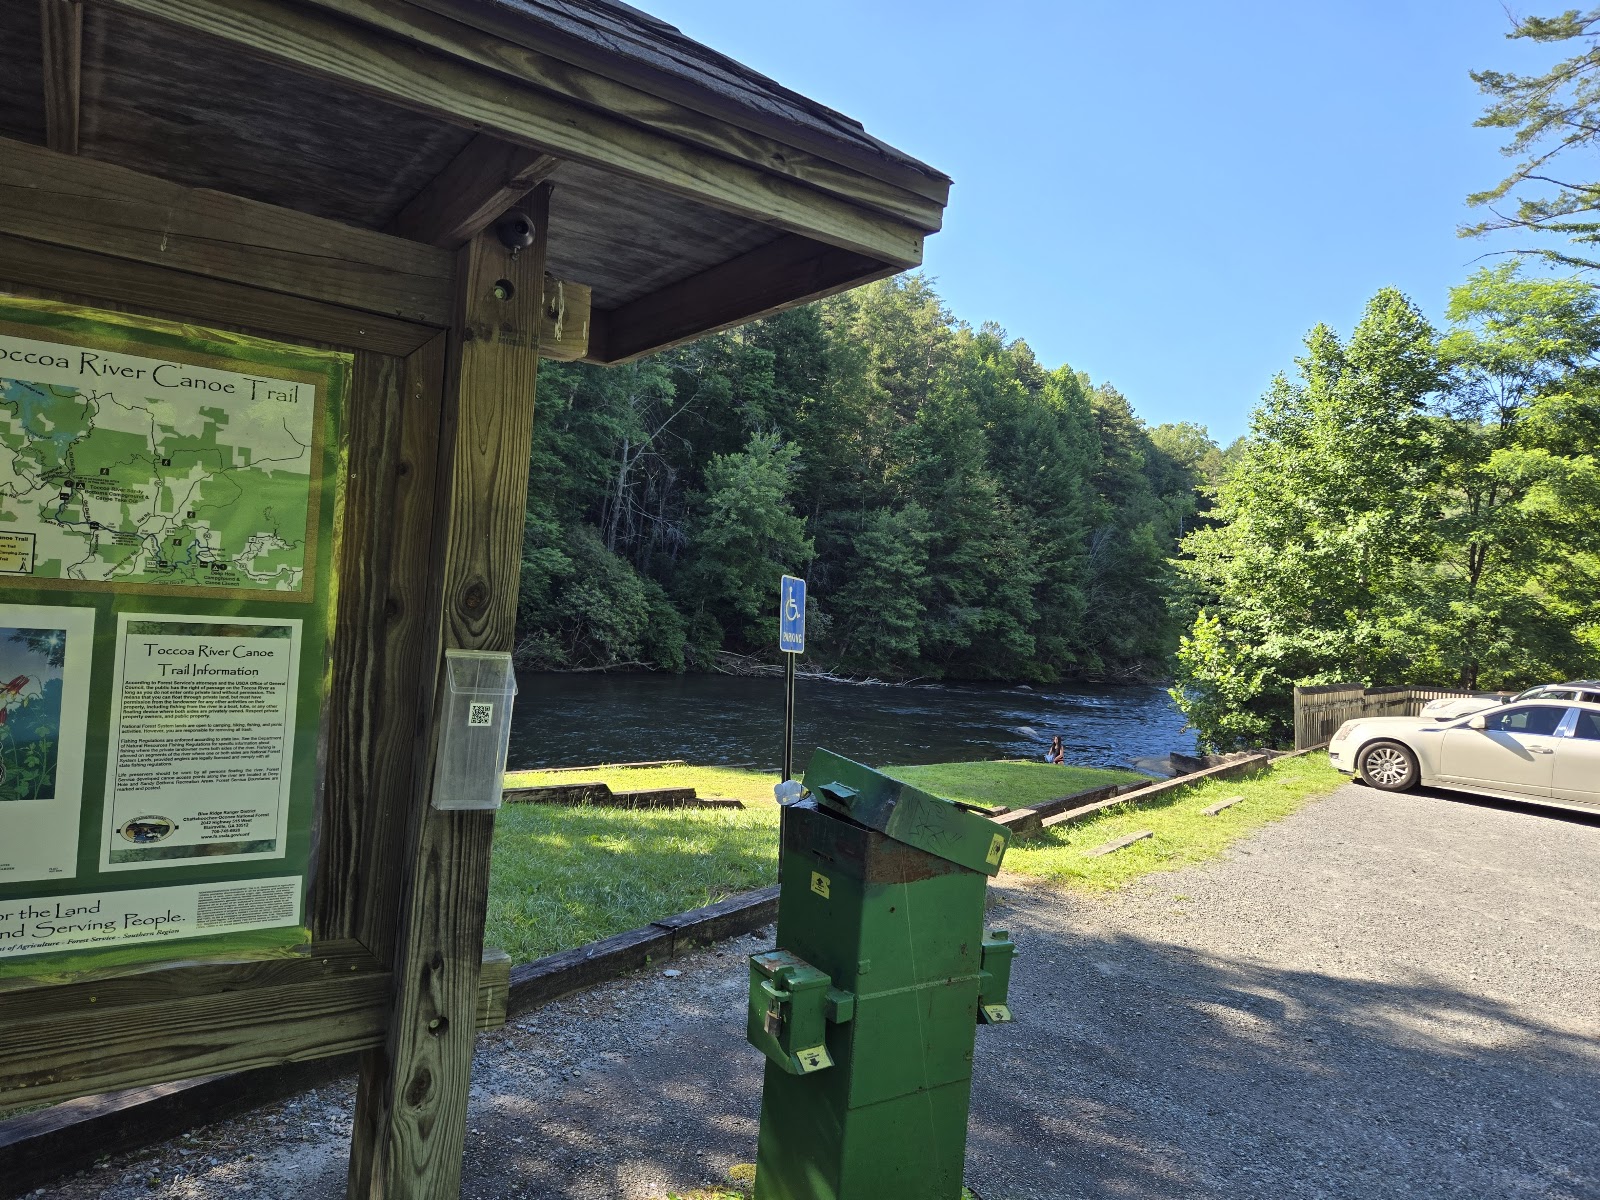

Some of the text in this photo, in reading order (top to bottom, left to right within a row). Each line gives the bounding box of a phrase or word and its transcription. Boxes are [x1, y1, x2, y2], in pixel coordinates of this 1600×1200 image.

[80, 352, 146, 379] River
[152, 364, 235, 394] Canoe
[243, 378, 298, 404] Trail
[144, 644, 274, 658] Toccoa River Canoe
[158, 664, 259, 676] Trail Information
[19, 904, 50, 920] the
[55, 900, 100, 918] Land
[32, 920, 116, 938] Serving
[124, 910, 186, 930] People.
[8, 944, 17, 952] of
[17, 942, 60, 950] Agriculture
